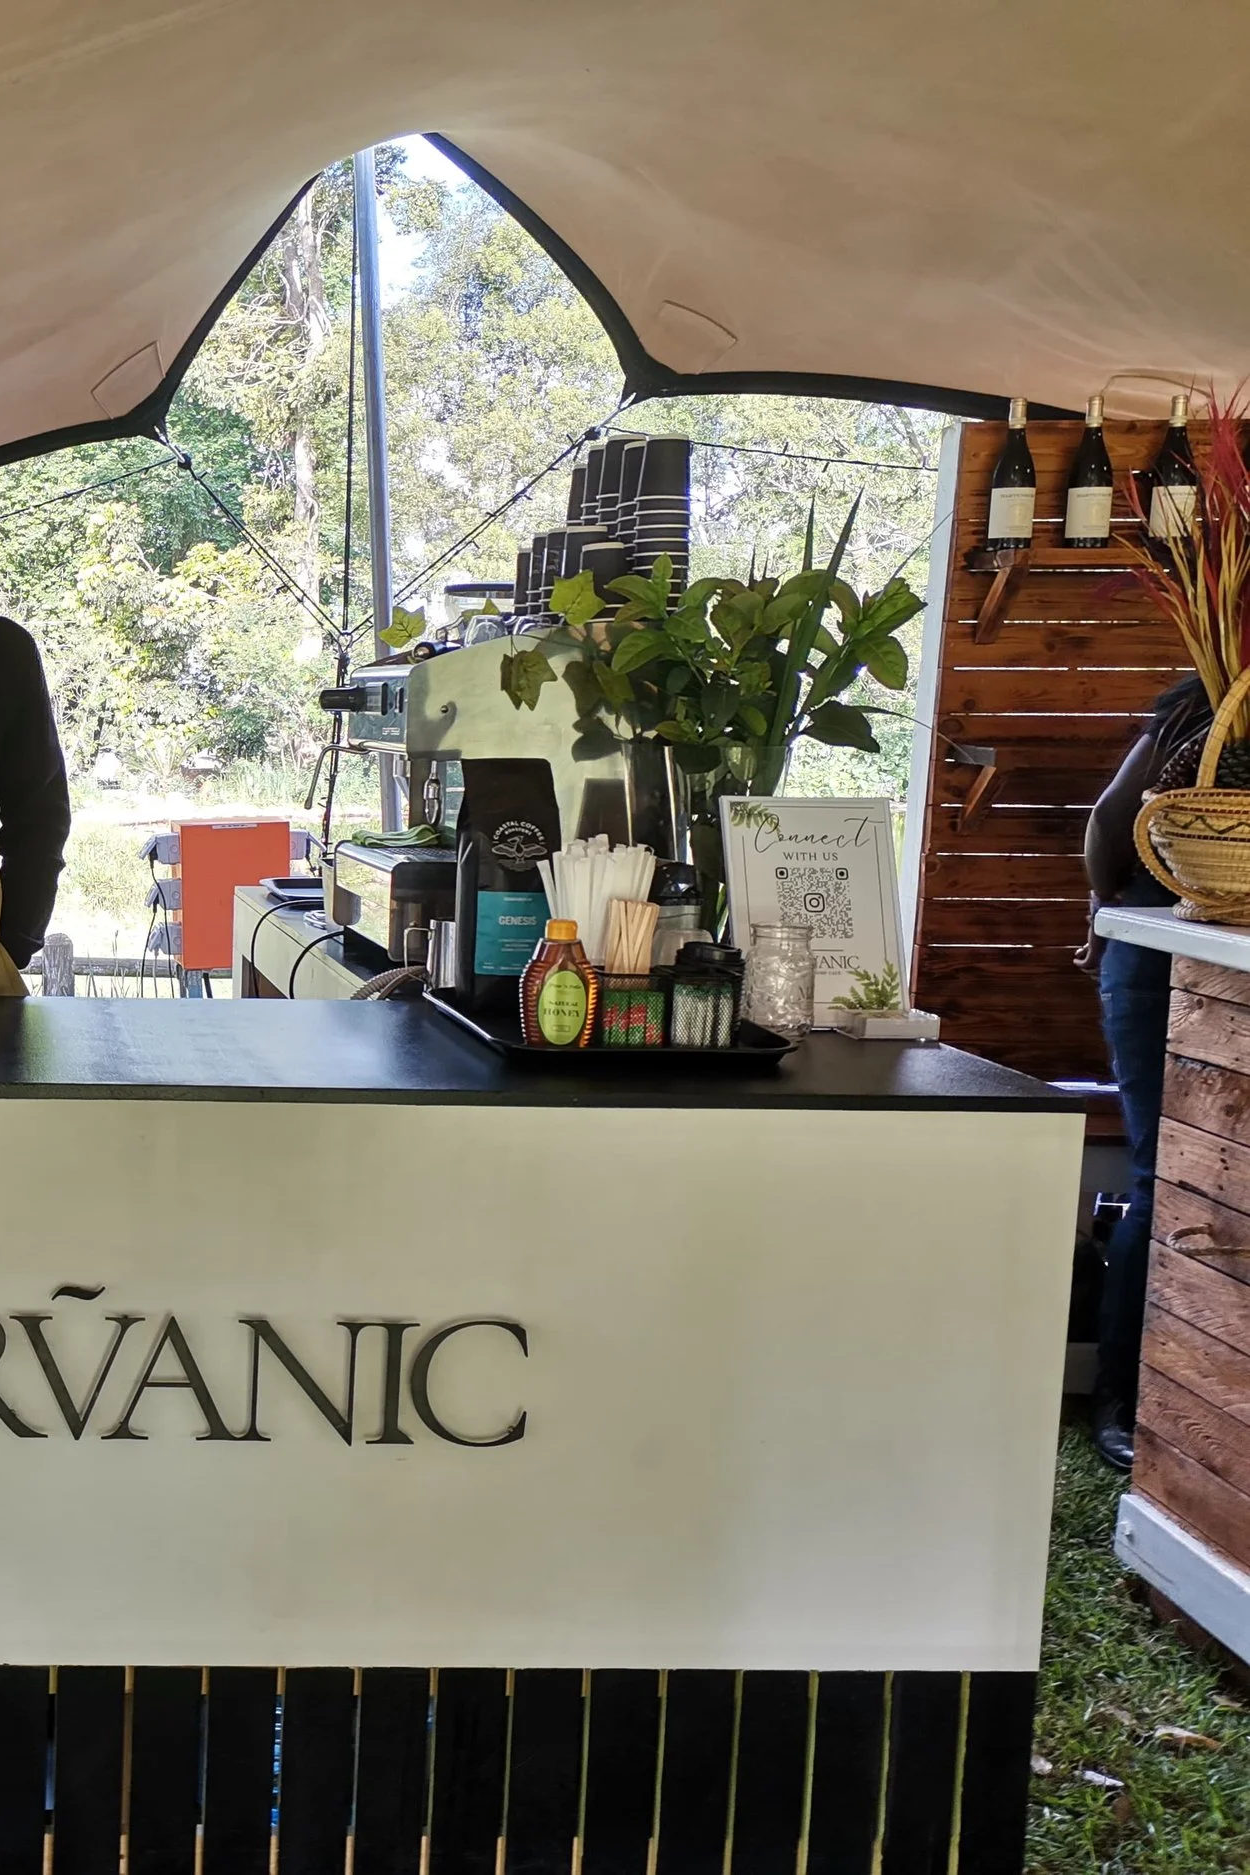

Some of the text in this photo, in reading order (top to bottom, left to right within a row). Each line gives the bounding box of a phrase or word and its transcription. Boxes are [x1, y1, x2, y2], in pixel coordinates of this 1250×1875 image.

[493, 821, 545, 841] COASTAL COFFEE
[754, 813, 886, 852] Connect
[783, 852, 839, 861] WITH US
[498, 916, 537, 926] GENESIS
[543, 1008, 580, 1018] HONEY
